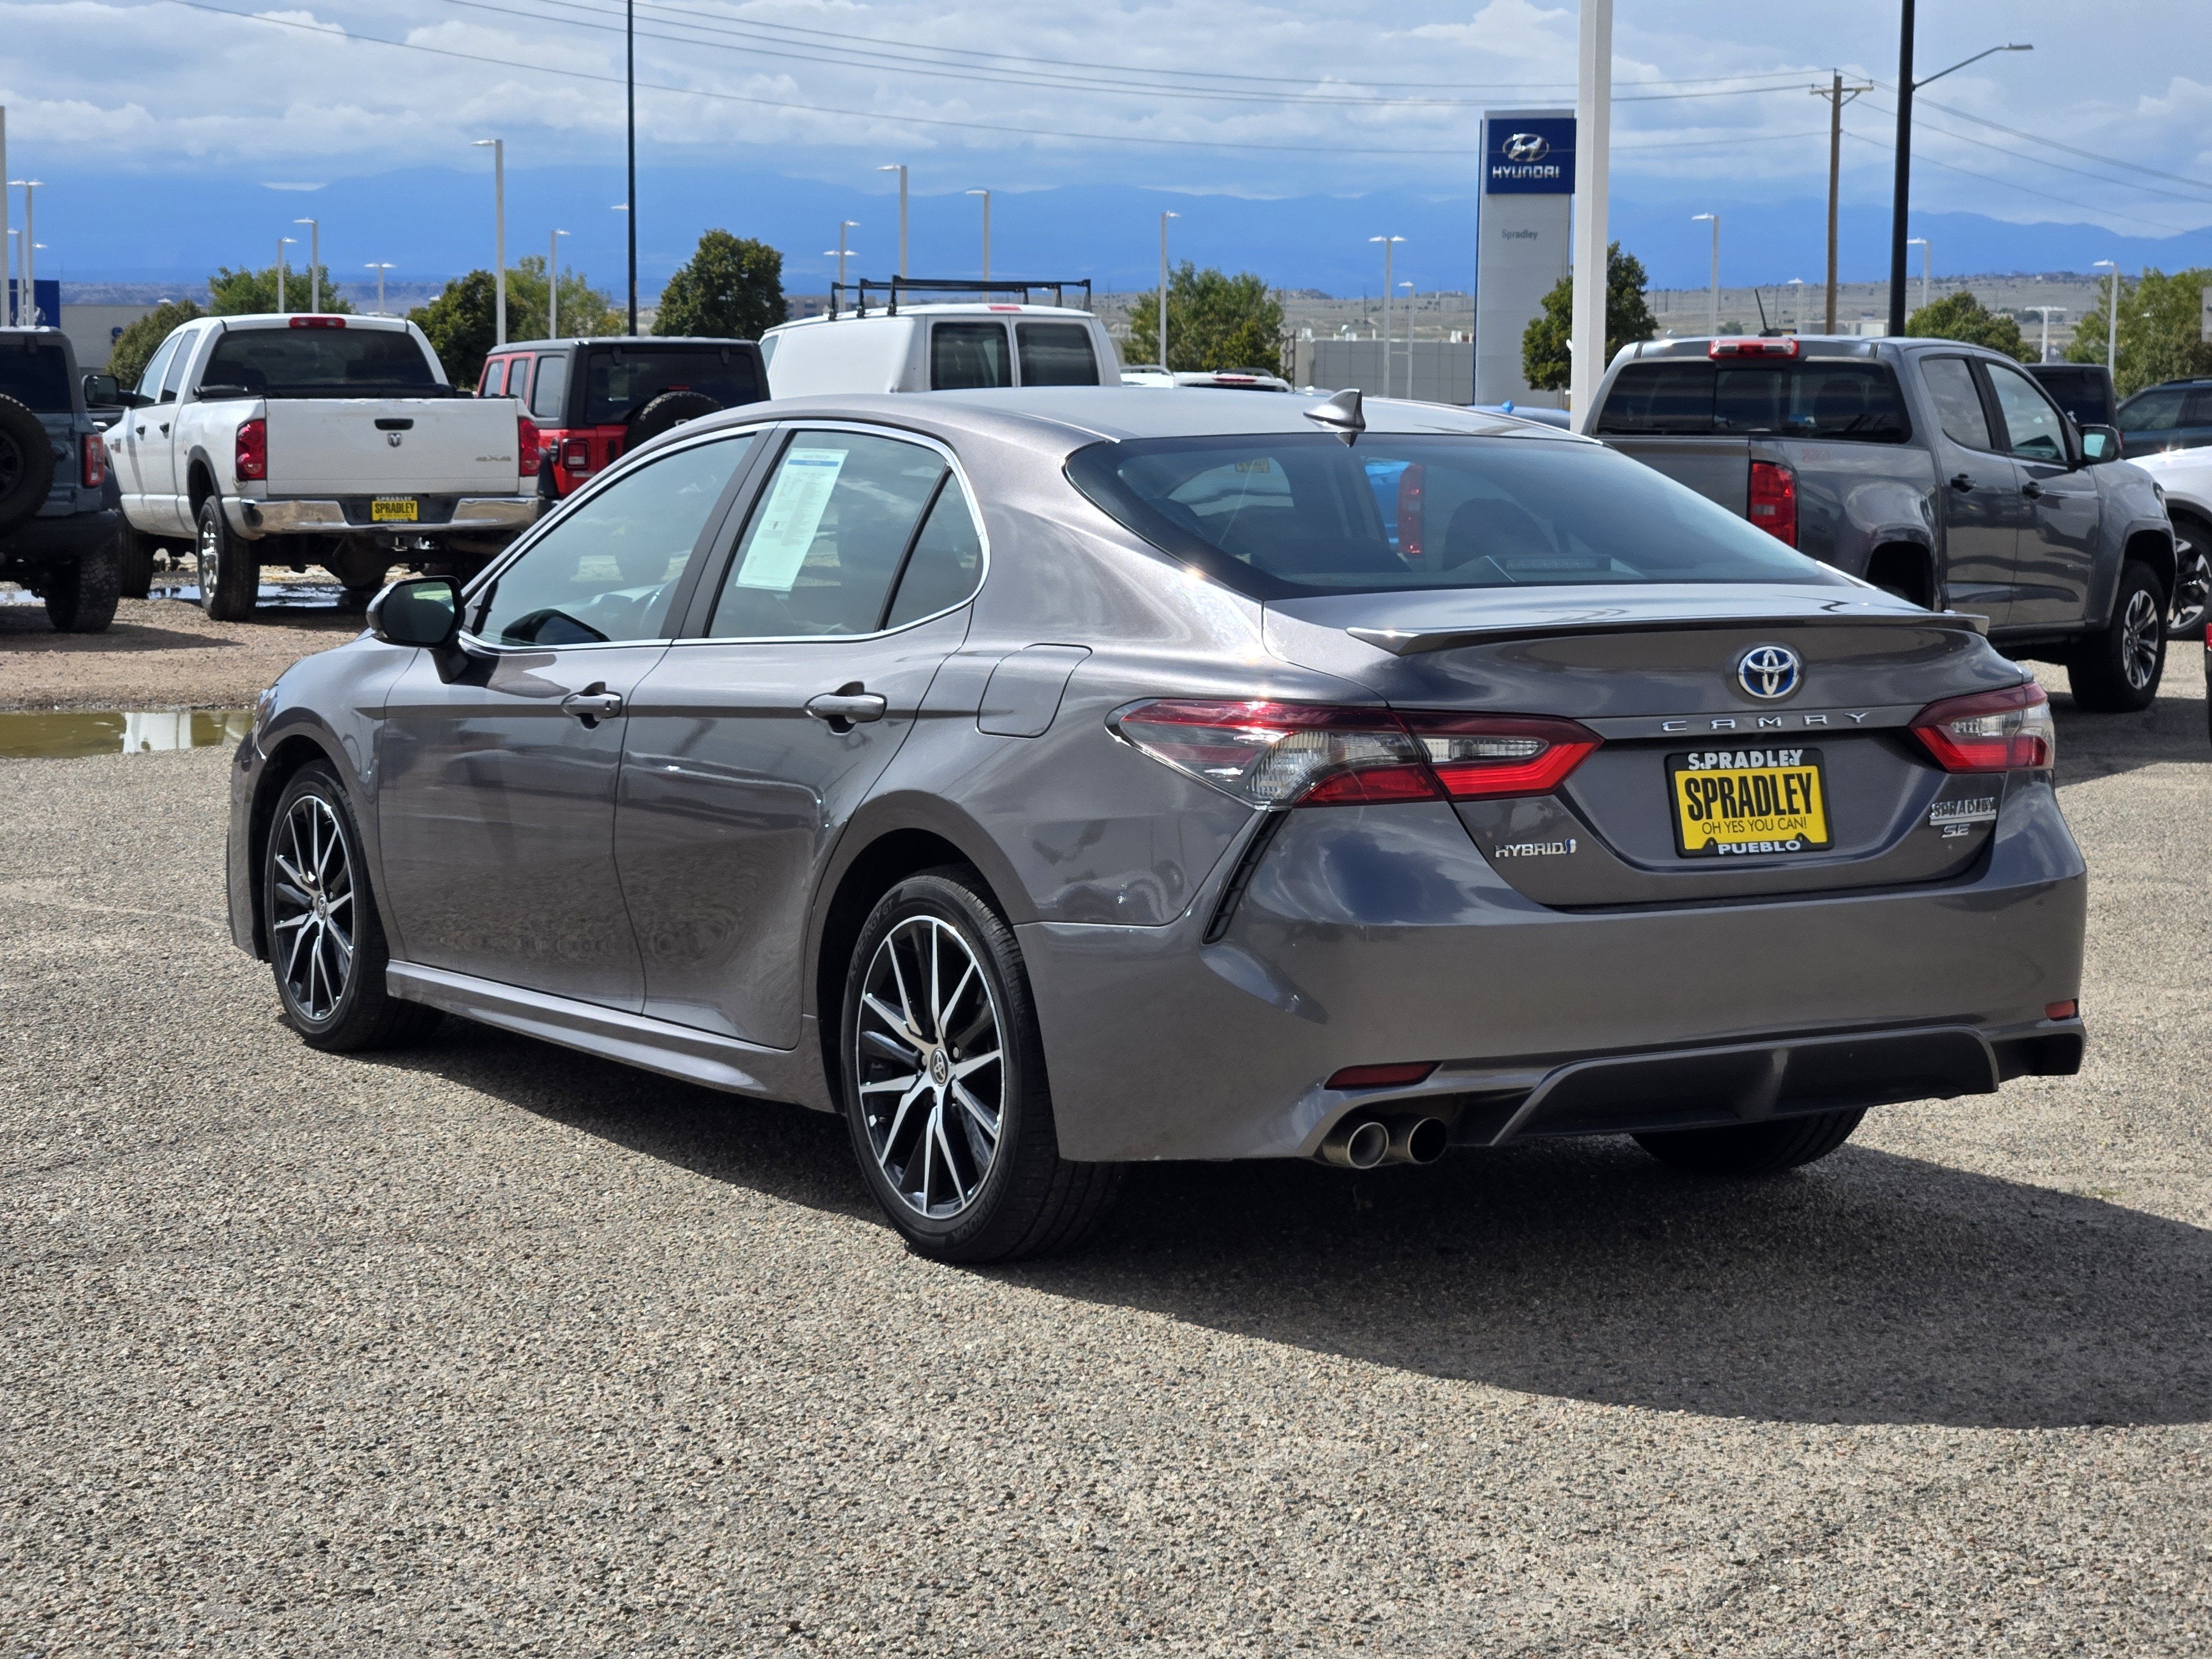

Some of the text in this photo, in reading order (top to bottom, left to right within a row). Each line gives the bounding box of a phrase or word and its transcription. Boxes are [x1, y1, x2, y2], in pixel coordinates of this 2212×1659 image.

[1493, 166, 1559, 178] HYUNDAI
[1502, 229, 1538, 240] Spradley
[375, 503, 415, 513] SPRADLEY
[1662, 712, 1870, 732] CAMRY
[1688, 749, 1803, 770] SPRADLEY
[1684, 773, 1812, 821] SPRADLEY
[1931, 797, 1995, 817] SPRADLEY
[1702, 817, 1807, 835] OH YES YOU CAN!
[1942, 823, 1970, 838] SE
[1495, 843, 1566, 858] HYBRID
[1718, 841, 1801, 854] PUEBLO
